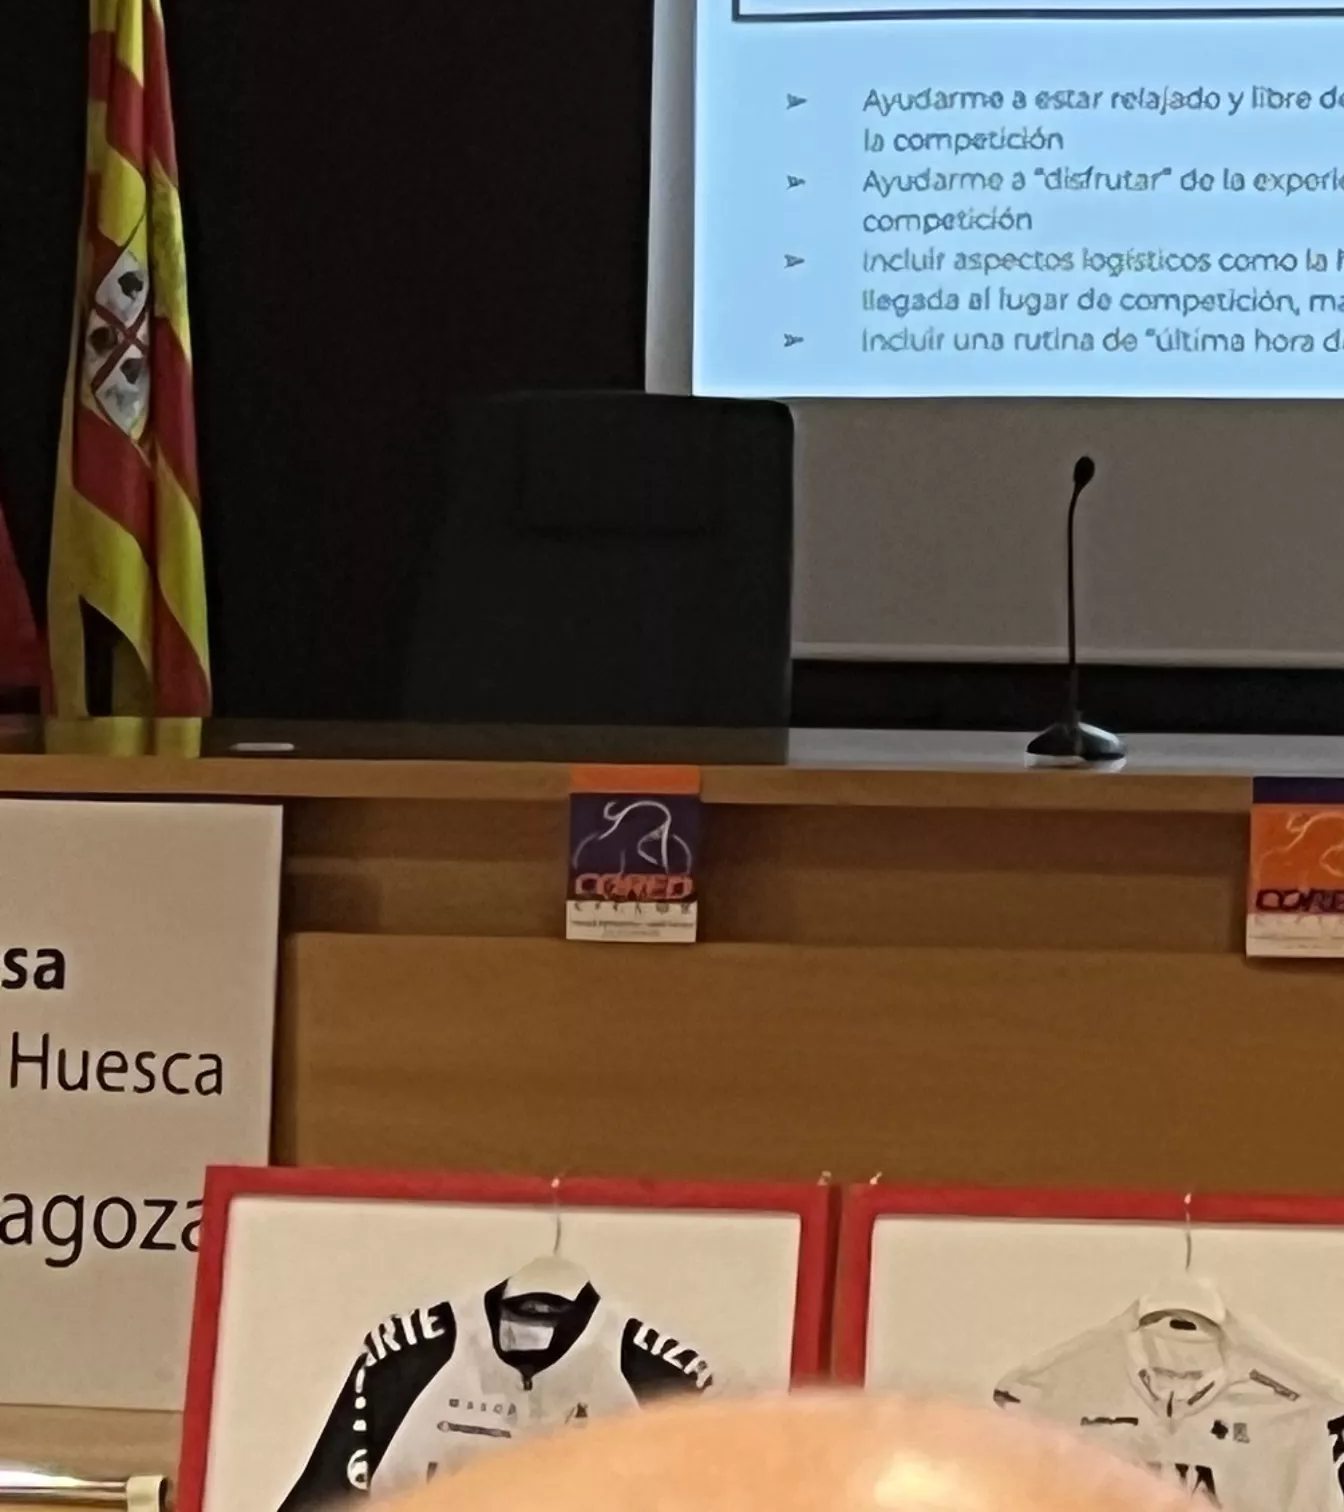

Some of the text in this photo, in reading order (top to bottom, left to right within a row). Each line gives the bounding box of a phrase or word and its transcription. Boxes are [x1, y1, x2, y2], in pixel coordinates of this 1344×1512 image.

[861, 86, 1005, 119] Ayudarme
[1033, 88, 1104, 112] estar
[1109, 84, 1222, 117] relajado
[1250, 84, 1314, 112] libre
[892, 124, 1066, 157] competición
[861, 166, 1005, 200] Ayudarme
[861, 204, 1034, 237] competición
[861, 245, 947, 274] Incluir
[952, 249, 1076, 277] aspectos
[1081, 246, 1213, 279] logísticos
[1216, 251, 1300, 274] como
[861, 286, 961, 320] llegada
[997, 285, 1071, 318] lugar
[1117, 286, 1302, 319] competición,
[861, 325, 947, 353] Incluir
[951, 331, 1006, 353] una
[1012, 325, 1096, 354] rutina
[1253, 326, 1316, 355] hora
[10, 1031, 223, 1097] Huesca
